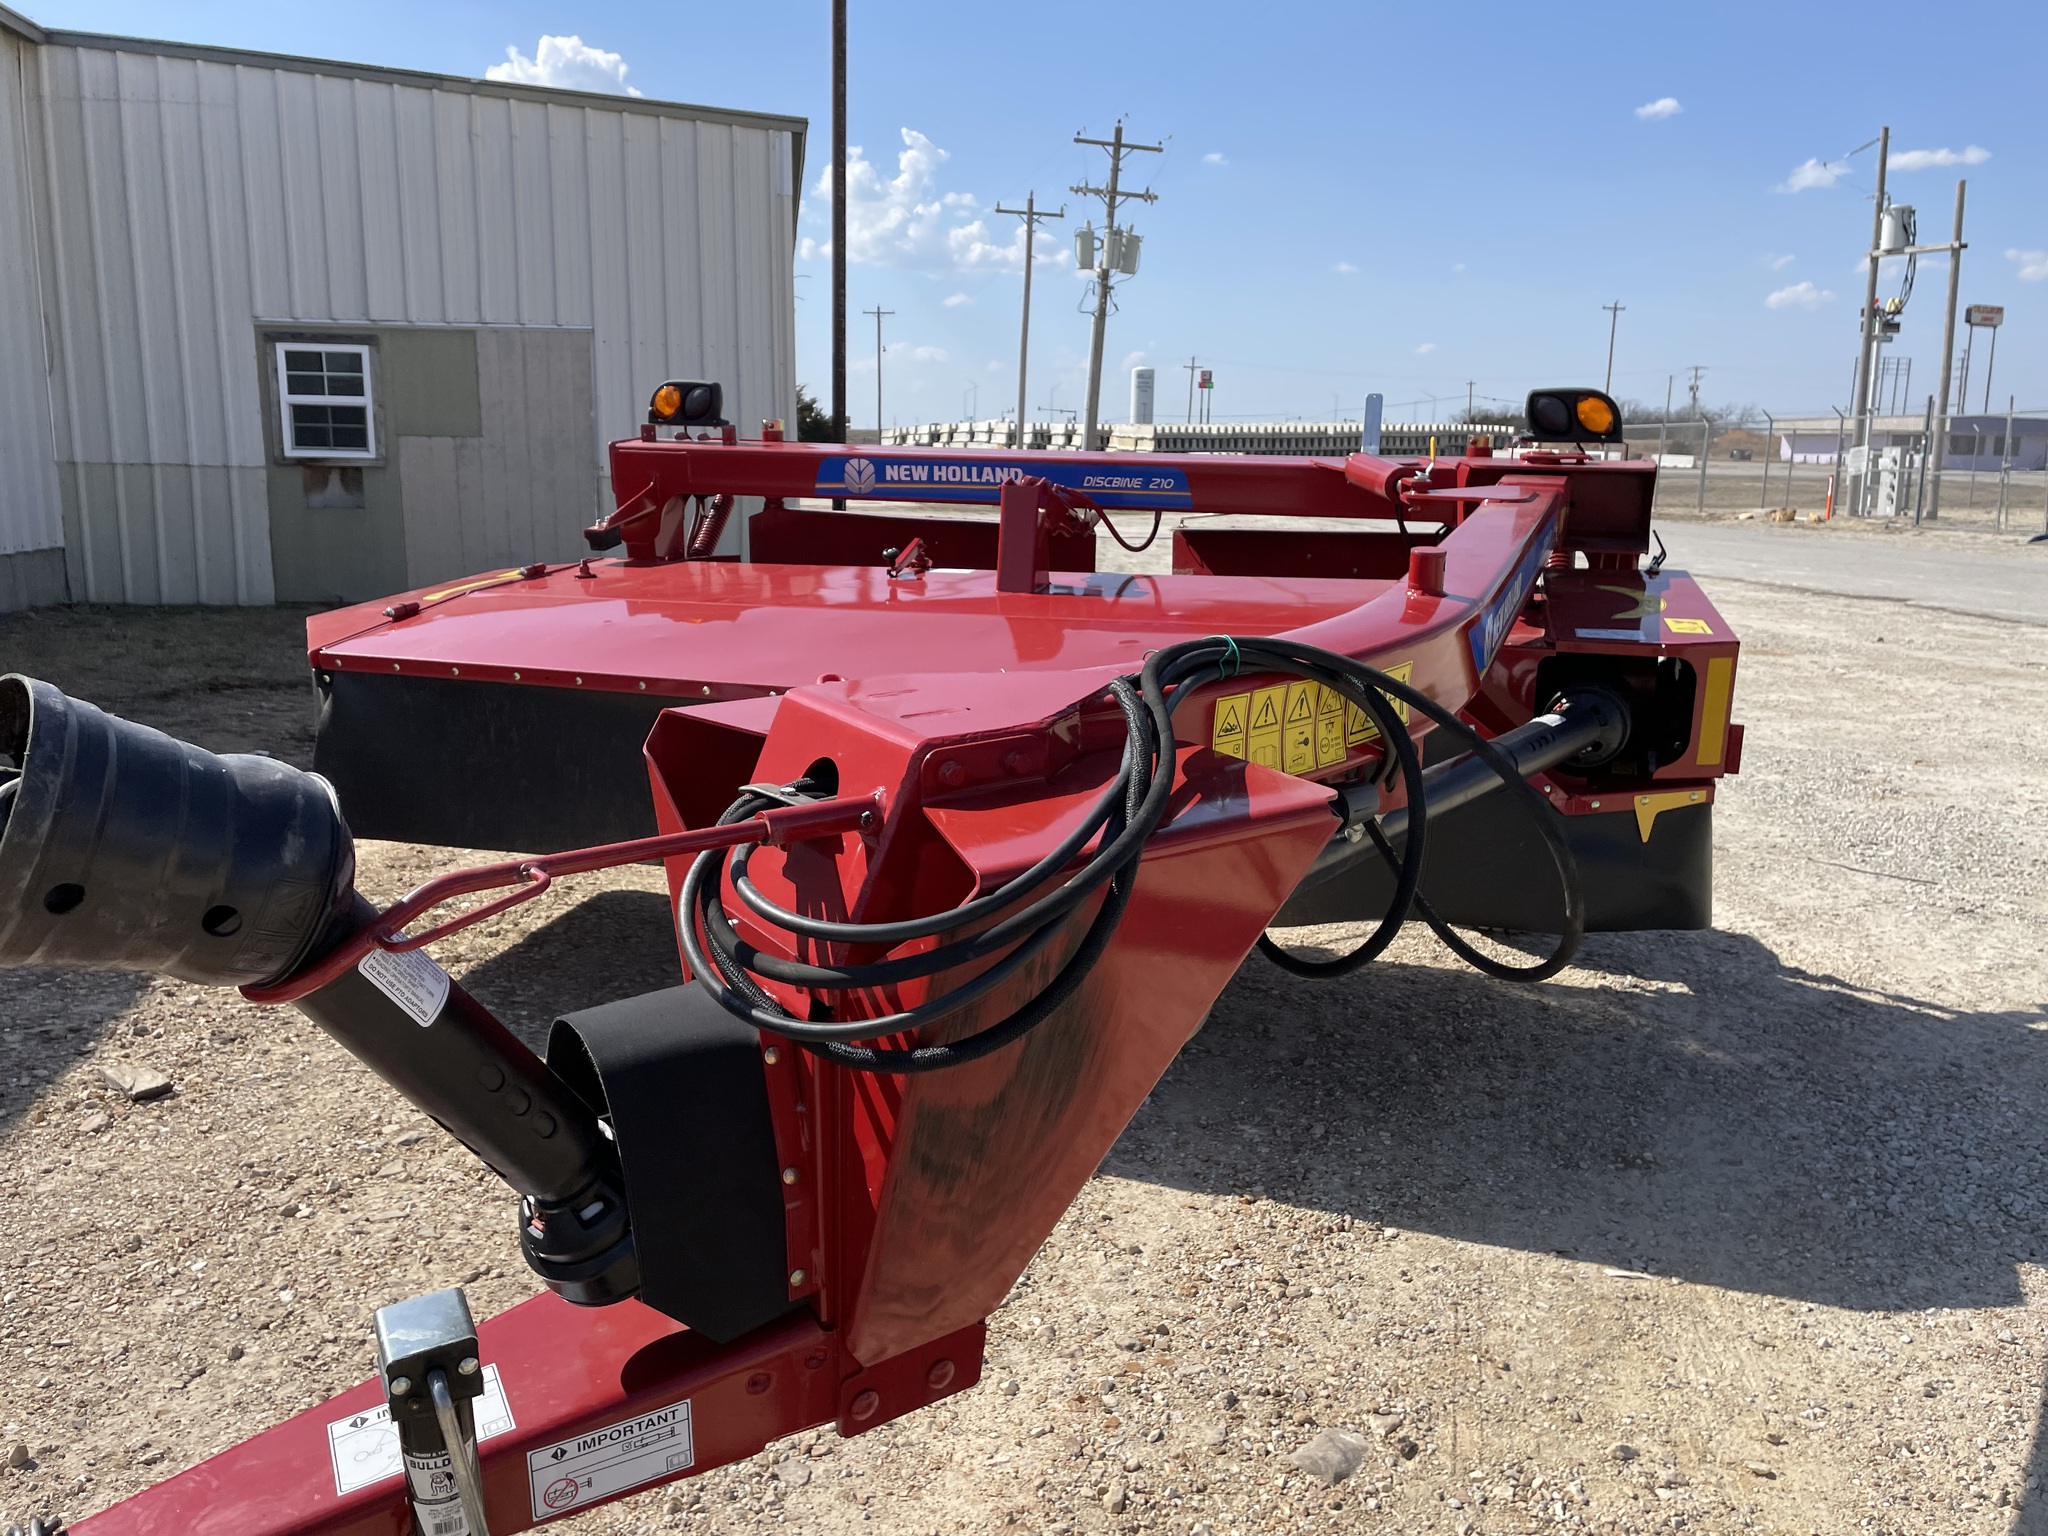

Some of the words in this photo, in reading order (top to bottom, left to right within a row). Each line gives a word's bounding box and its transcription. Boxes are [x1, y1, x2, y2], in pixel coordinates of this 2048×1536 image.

[886, 465, 928, 480] NEW
[934, 466, 1023, 483] HOLLAND
[1083, 476, 1143, 488] DISCBINE
[1149, 478, 1174, 488] 210
[374, 957, 391, 974] READING
[368, 963, 376, 972] DO
[375, 969, 387, 980] NOT
[384, 978, 396, 989] USE
[394, 986, 406, 997] PTO
[403, 995, 428, 1017] ADAPTORS
[578, 1409, 679, 1452] IMPORTANT
[410, 1458, 451, 1470] BULLD
